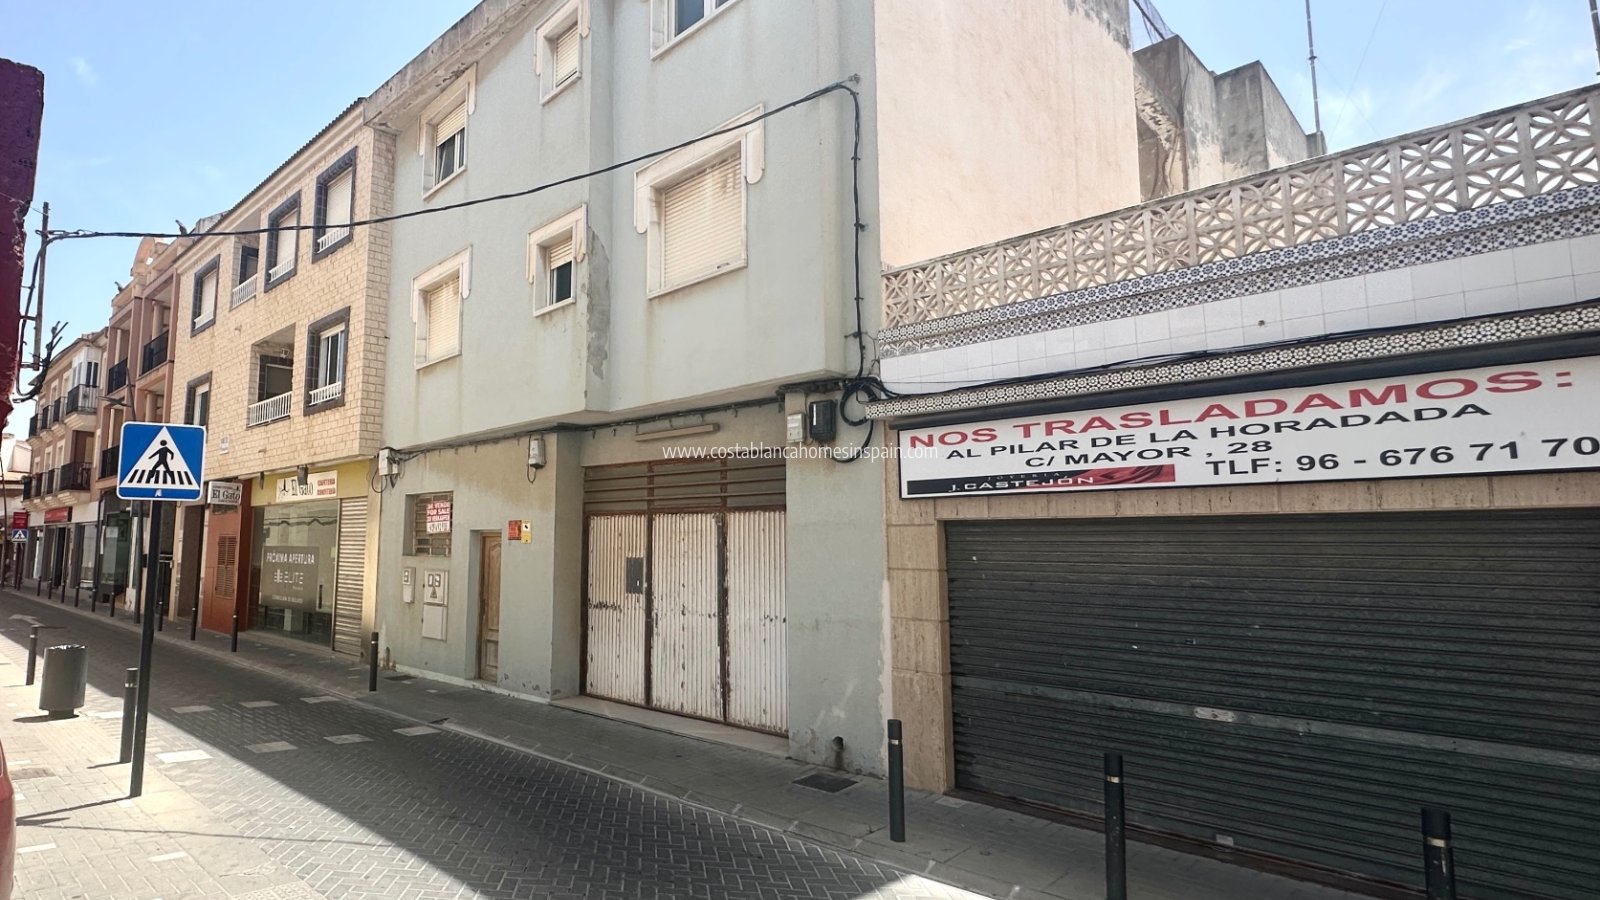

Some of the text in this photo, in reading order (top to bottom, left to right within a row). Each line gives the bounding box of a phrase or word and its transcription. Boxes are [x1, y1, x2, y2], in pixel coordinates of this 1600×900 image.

[909, 370, 1573, 449] NOS TRASLADAMOS:
[946, 403, 1491, 460] AL PILAR DE LA HORADADA
[1025, 455, 1054, 468] C/
[1065, 445, 1192, 466] MAYOR
[1227, 440, 1272, 454] 28
[1205, 457, 1282, 476] TLF:
[1296, 452, 1339, 471] 96
[1379, 446, 1455, 466] 676
[1469, 440, 1519, 461] 71
[1541, 436, 1600, 457] 70
[211, 489, 241, 501] El Gato
[964, 476, 1094, 490] CASTEJÓN
[288, 553, 315, 565] APERTURA
